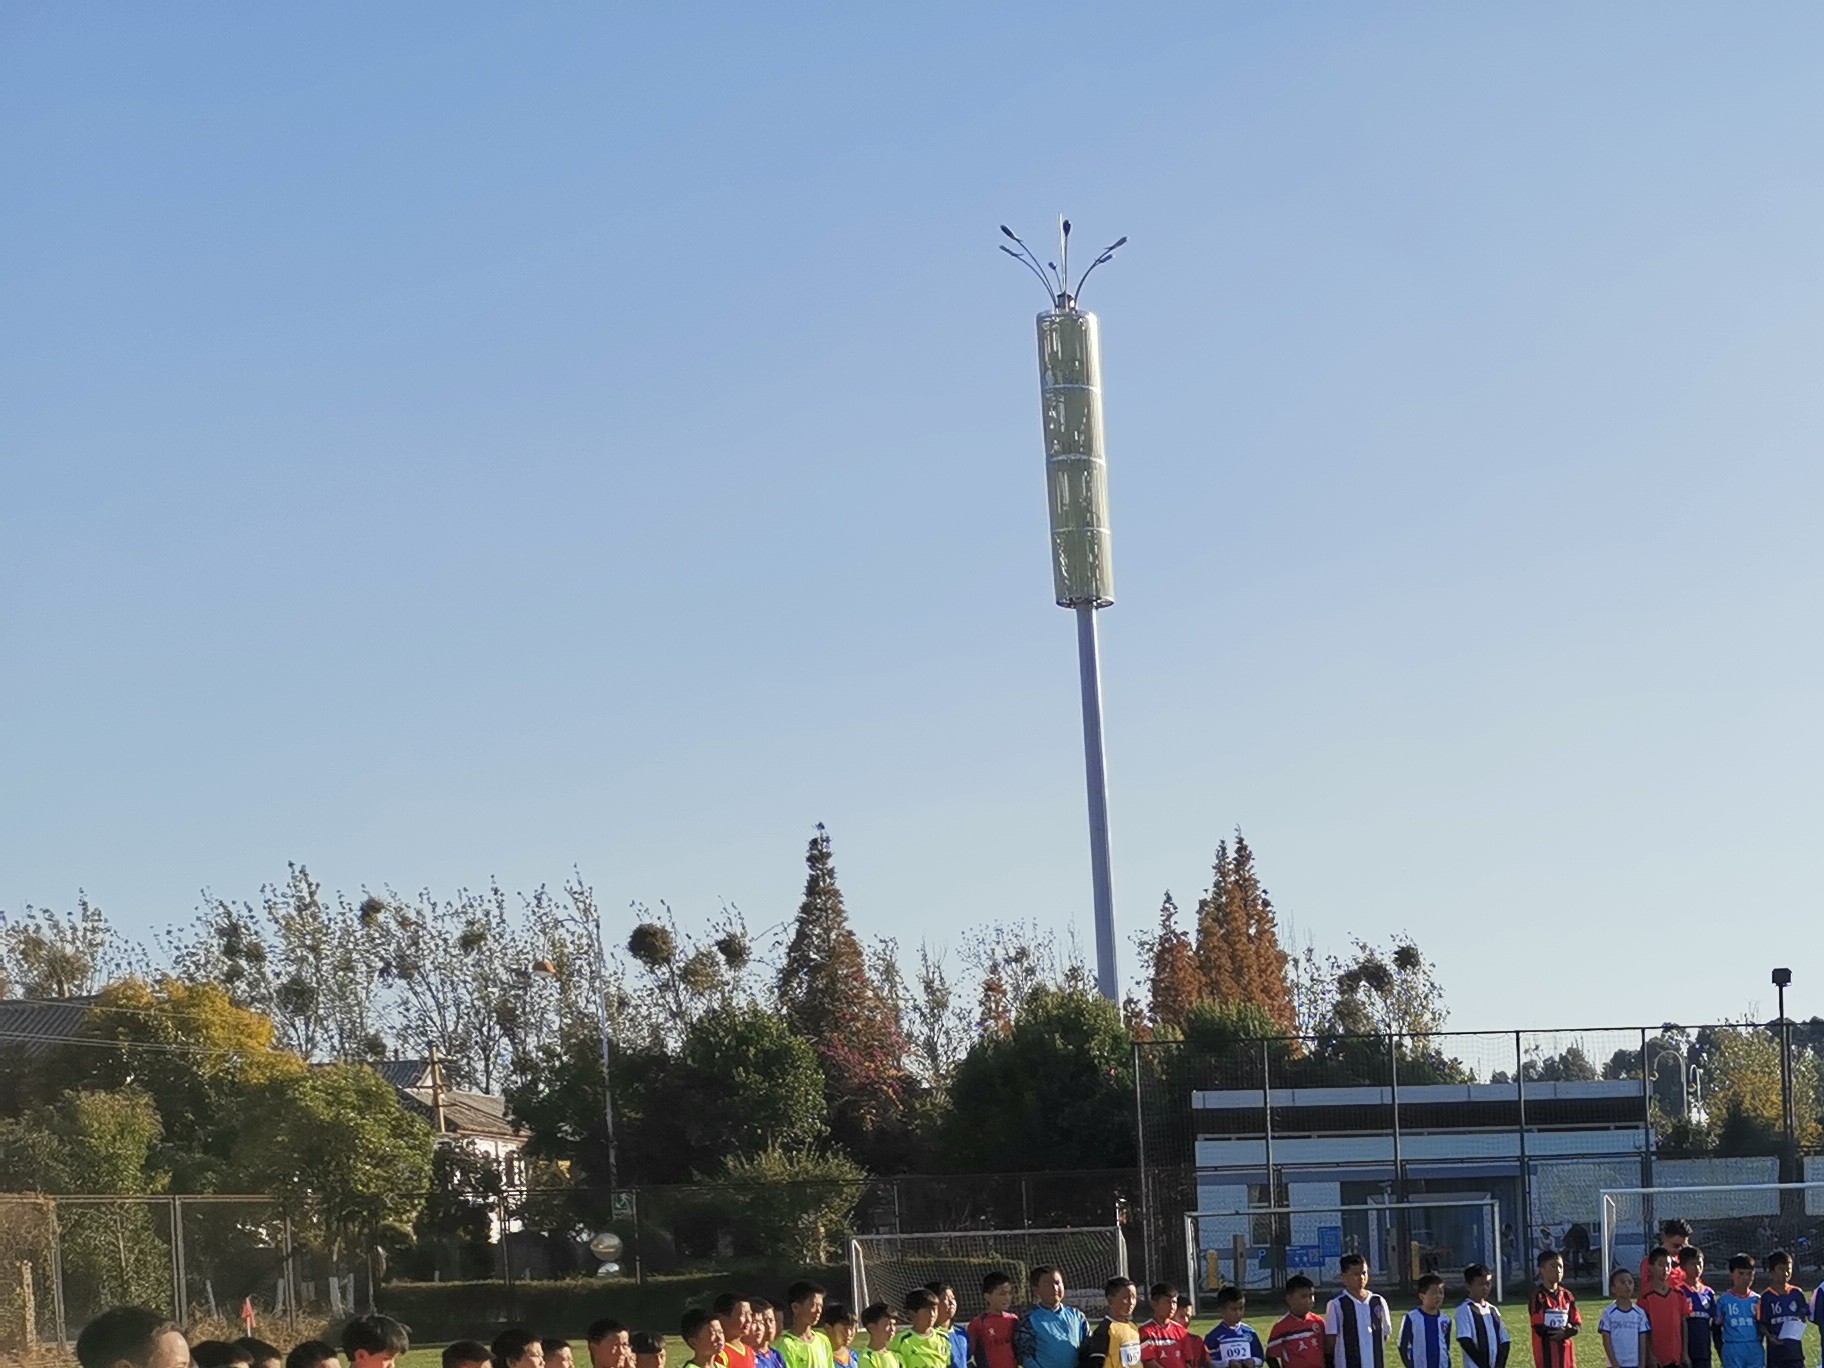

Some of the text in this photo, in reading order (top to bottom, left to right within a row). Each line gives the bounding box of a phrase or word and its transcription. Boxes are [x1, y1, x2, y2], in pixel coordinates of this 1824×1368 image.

[1728, 1303, 1739, 1316] 16
[1771, 1301, 1782, 1315] 16
[1227, 1347, 1247, 1358] 092
